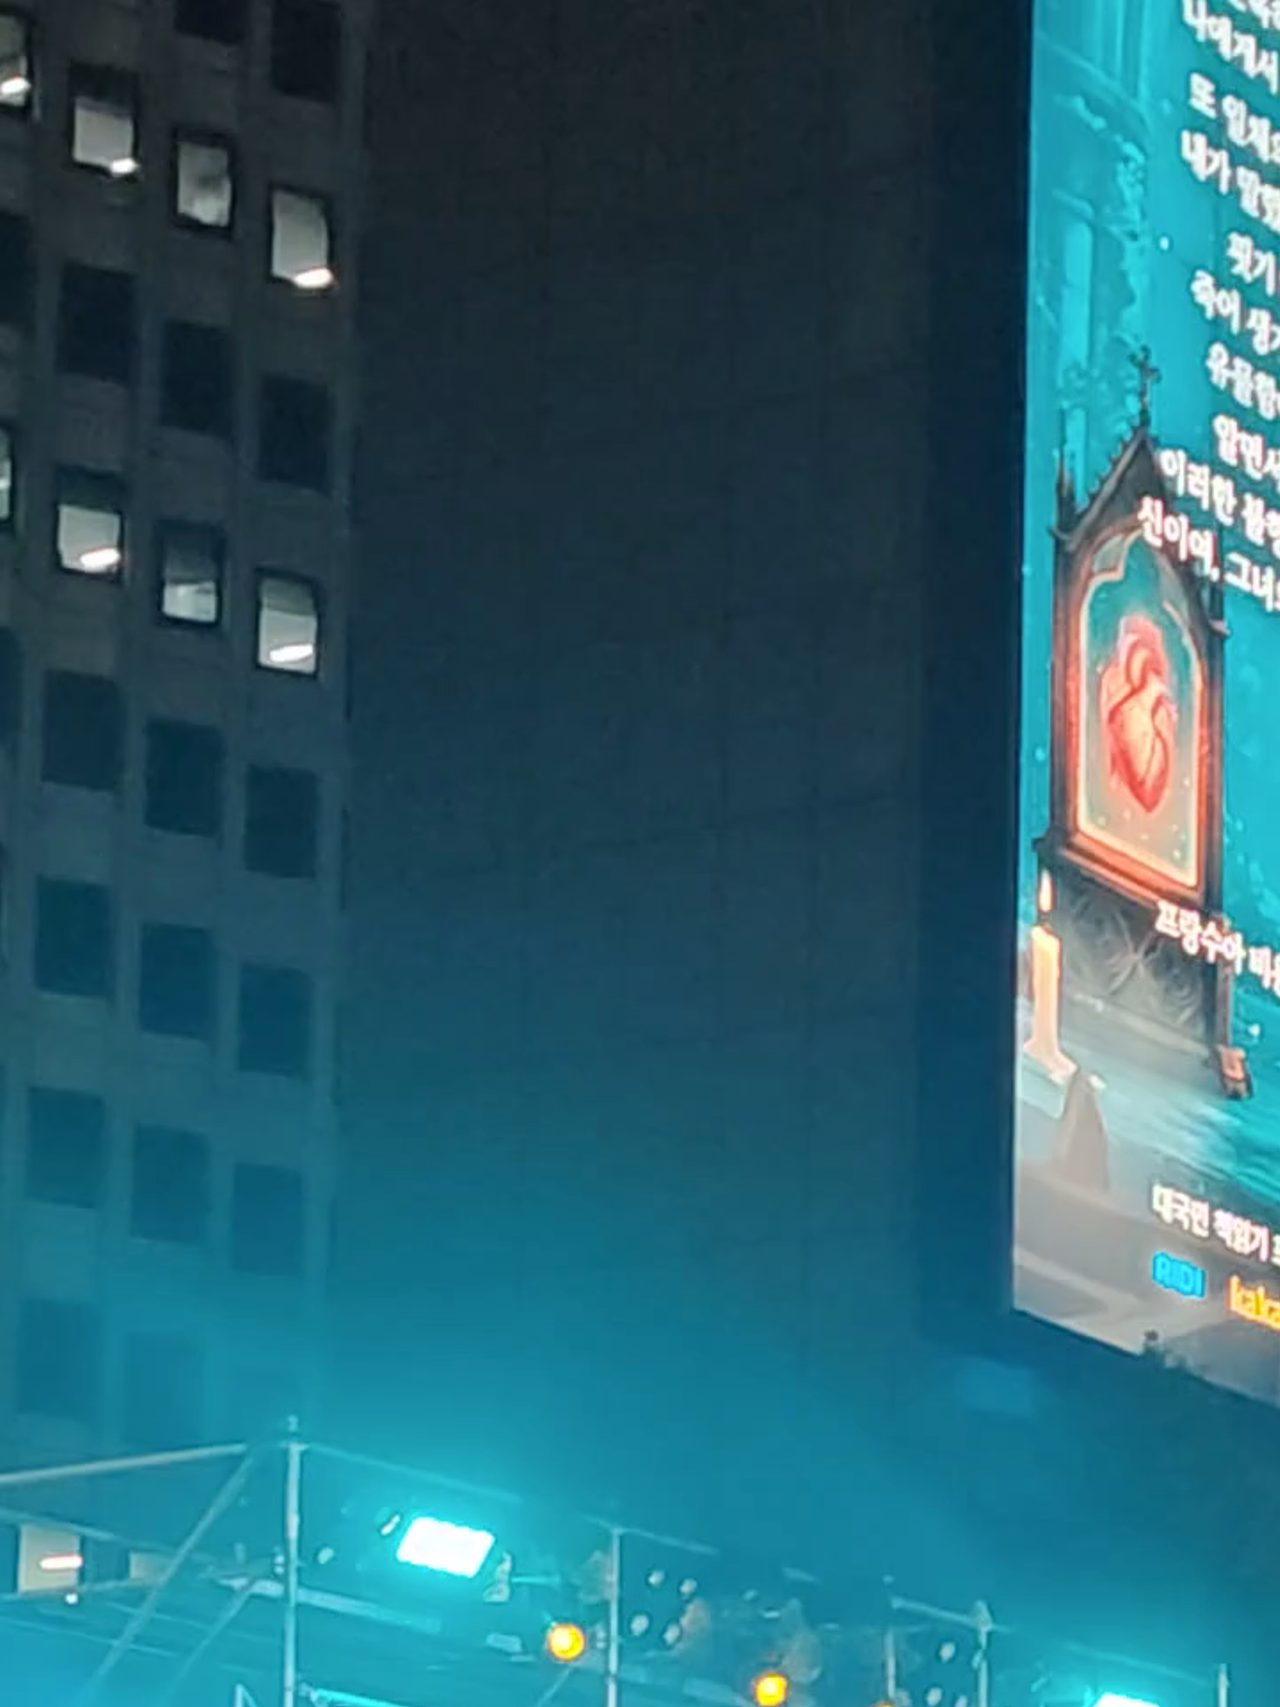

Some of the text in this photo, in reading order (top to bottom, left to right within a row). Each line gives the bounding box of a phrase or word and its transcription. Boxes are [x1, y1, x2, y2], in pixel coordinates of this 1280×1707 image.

[1189, 71, 1217, 119] 또
[1181, 129, 1231, 195] 내가
[1226, 231, 1276, 296] 핏기
[1190, 269, 1241, 335] 죽어
[1159, 448, 1237, 527] 이러한
[1137, 496, 1220, 583] 신이여,
[1154, 899, 1246, 976] 프랑수아
[1152, 1182, 1210, 1238] 대국민
